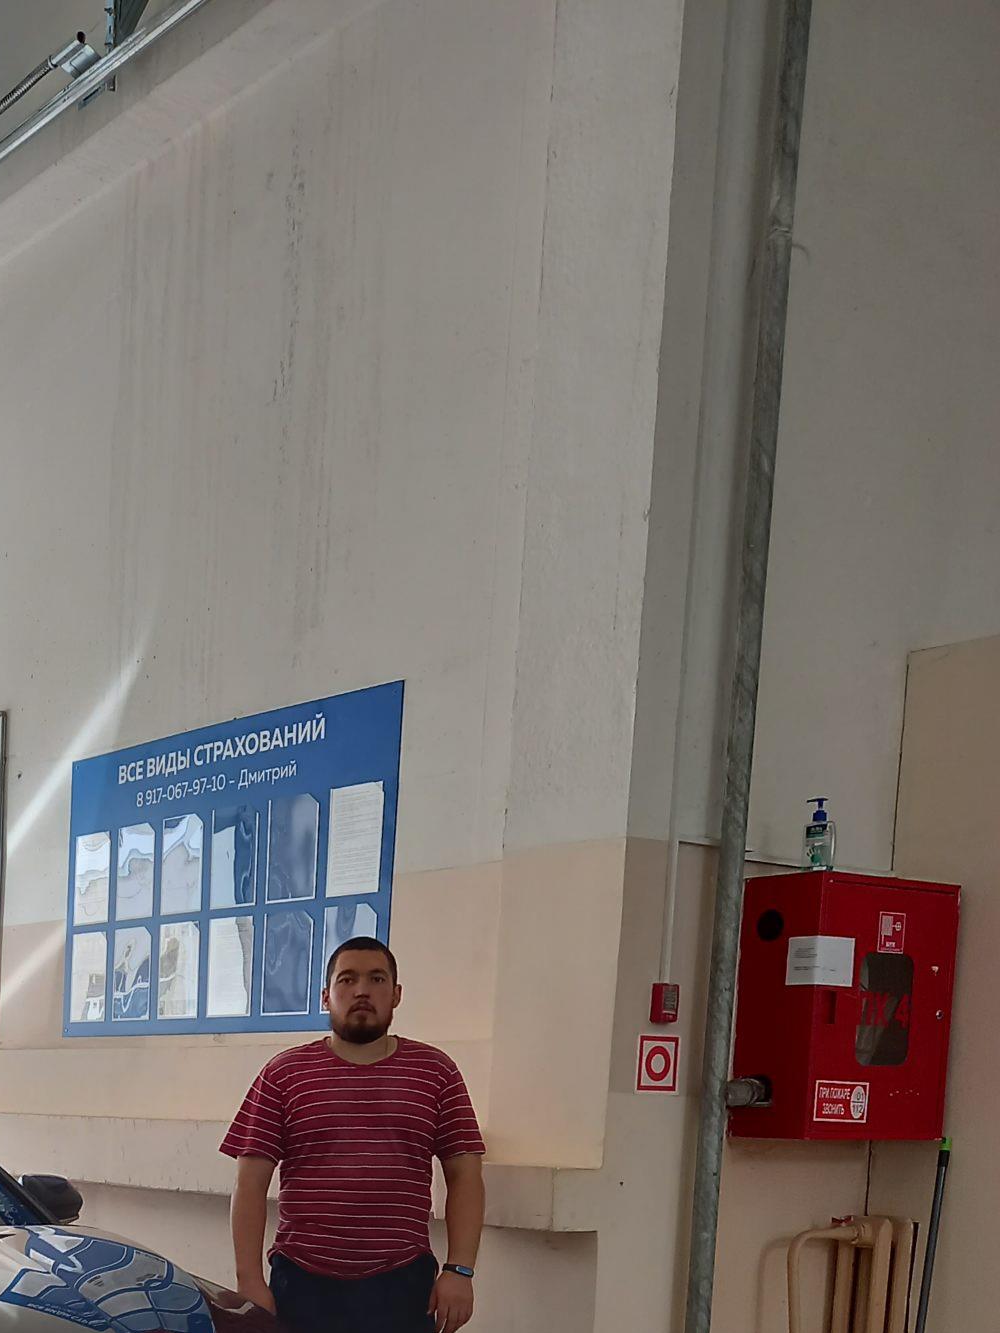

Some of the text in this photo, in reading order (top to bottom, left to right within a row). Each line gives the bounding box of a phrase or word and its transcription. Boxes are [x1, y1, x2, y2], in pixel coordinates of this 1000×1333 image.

[118, 712, 327, 784] ВСЕ ВИДЫ СТРАХОВАНИЙ
[136, 791, 144, 808] 8
[145, 774, 226, 806] 917-067-97-10
[238, 760, 297, 790] Дмитрий
[822, 1102, 845, 1115] ЗВОНИТЬ
